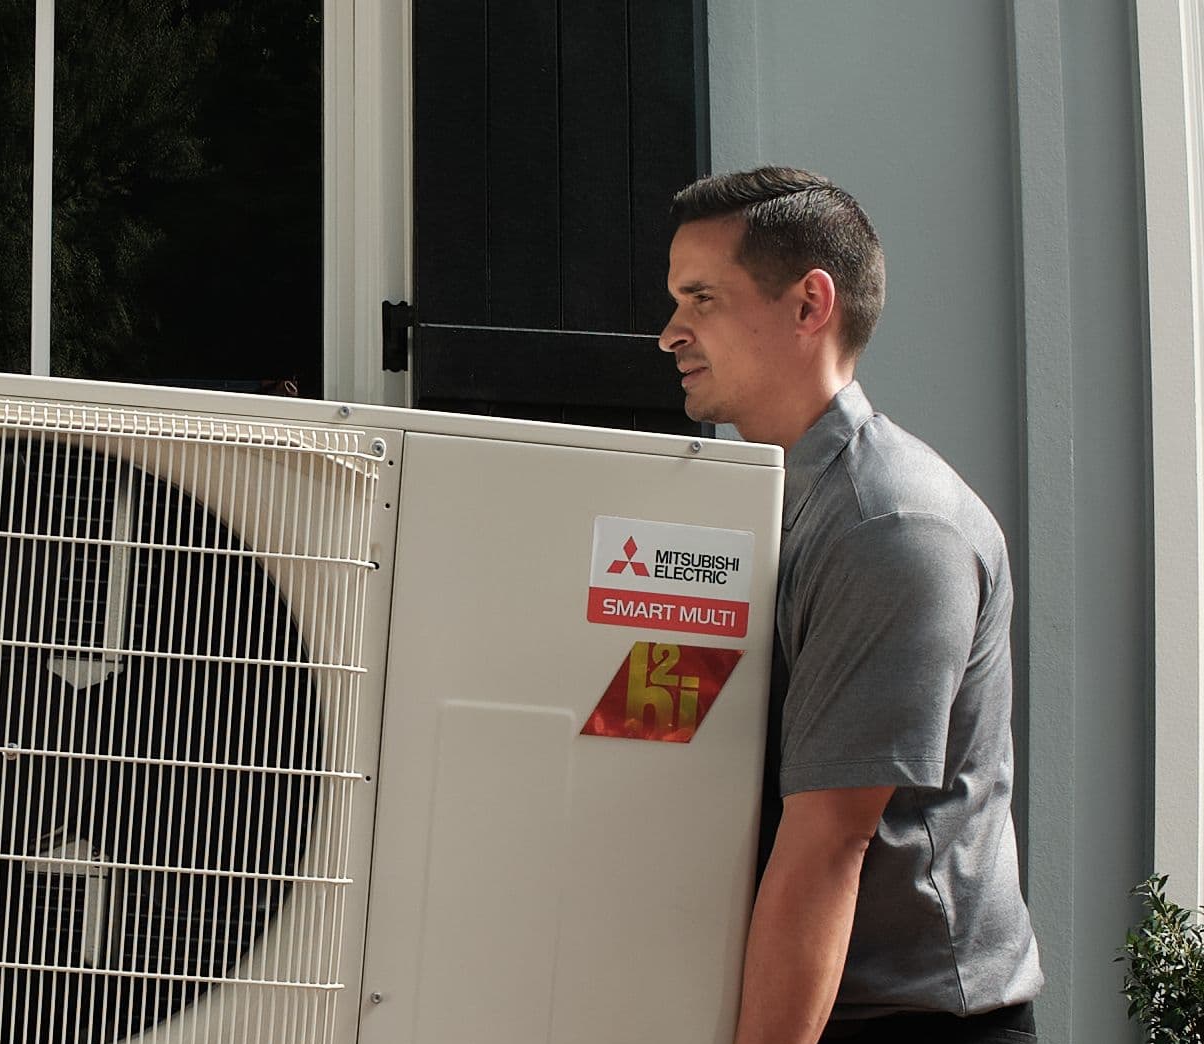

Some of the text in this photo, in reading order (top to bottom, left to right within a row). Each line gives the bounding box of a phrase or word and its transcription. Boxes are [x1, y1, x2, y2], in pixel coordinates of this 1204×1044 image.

[655, 549, 740, 571] MITSUBISHI
[654, 564, 727, 584] ELECTRIC
[602, 598, 736, 627] SMART MULTI
